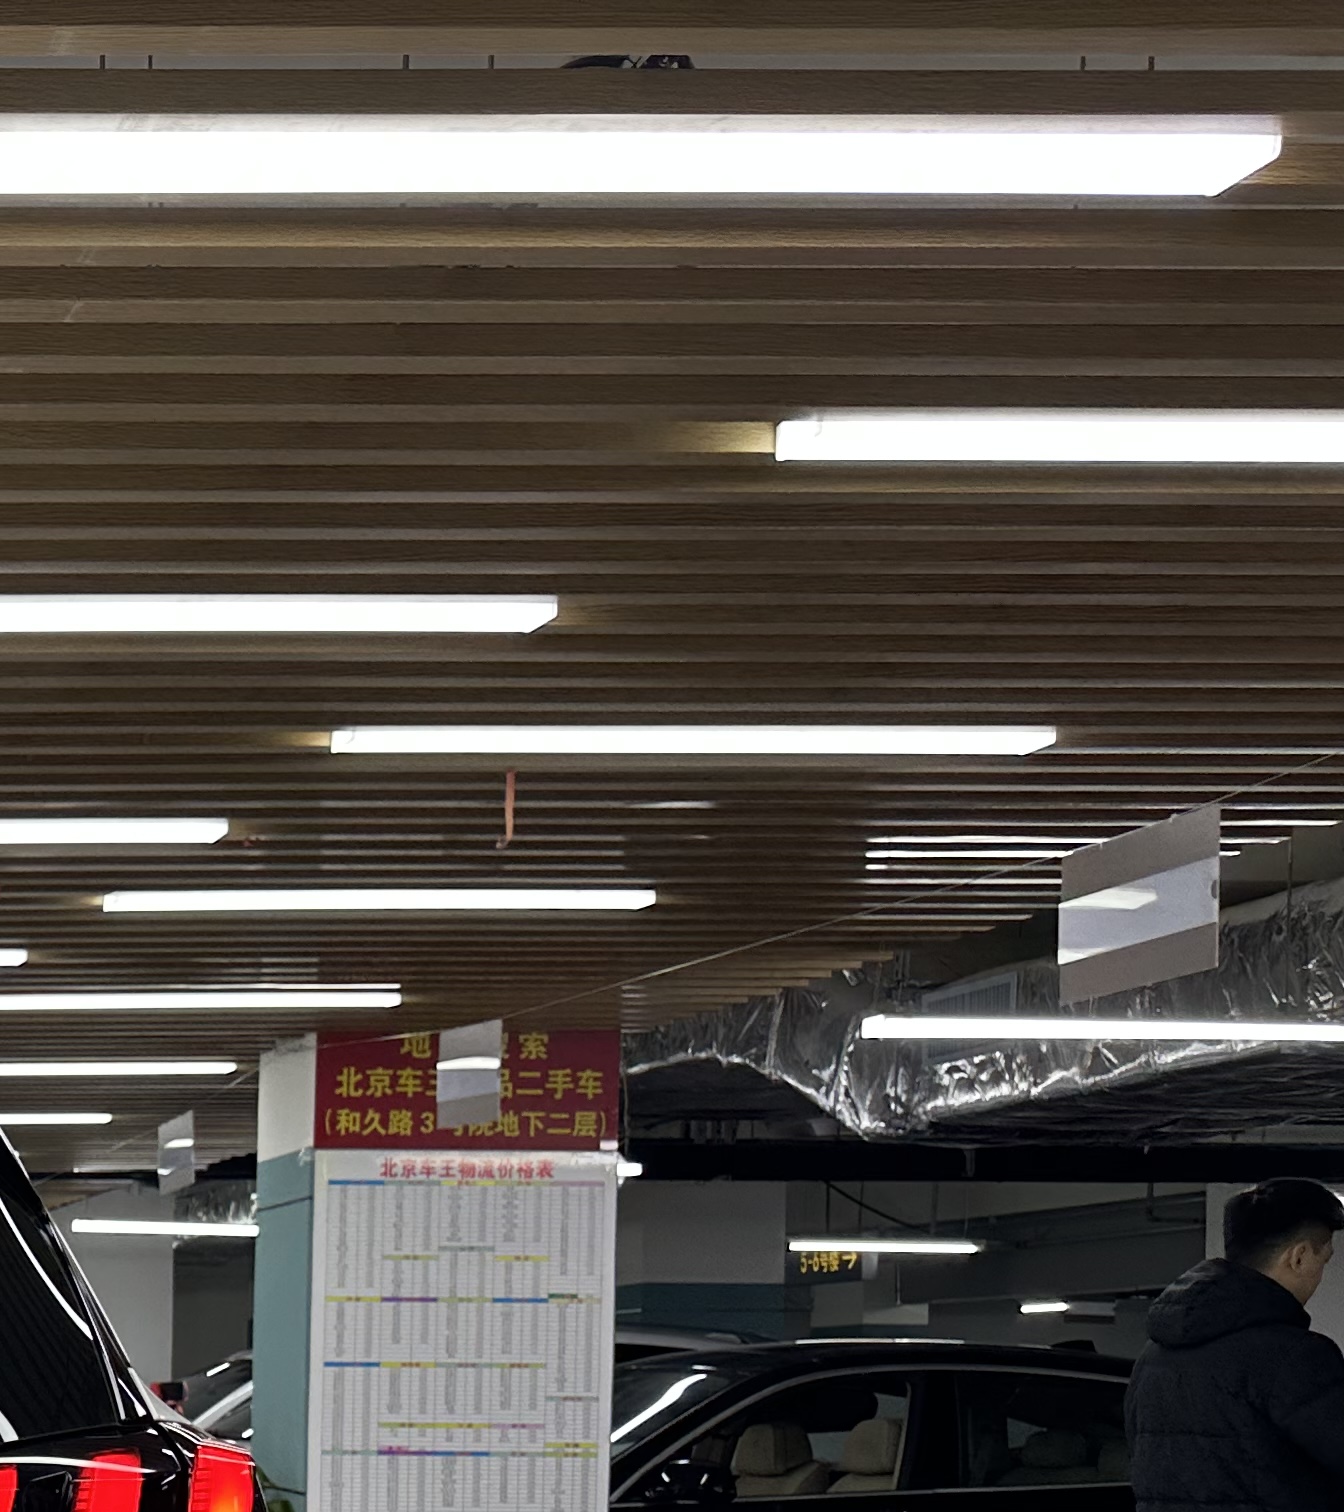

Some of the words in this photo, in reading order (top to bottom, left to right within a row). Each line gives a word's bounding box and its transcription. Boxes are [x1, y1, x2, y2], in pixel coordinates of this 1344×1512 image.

[400, 1032, 550, 1060] 地索
[334, 1066, 604, 1100] 北京车二手车
[380, 1156, 554, 1179] 北京车王物流价格表
